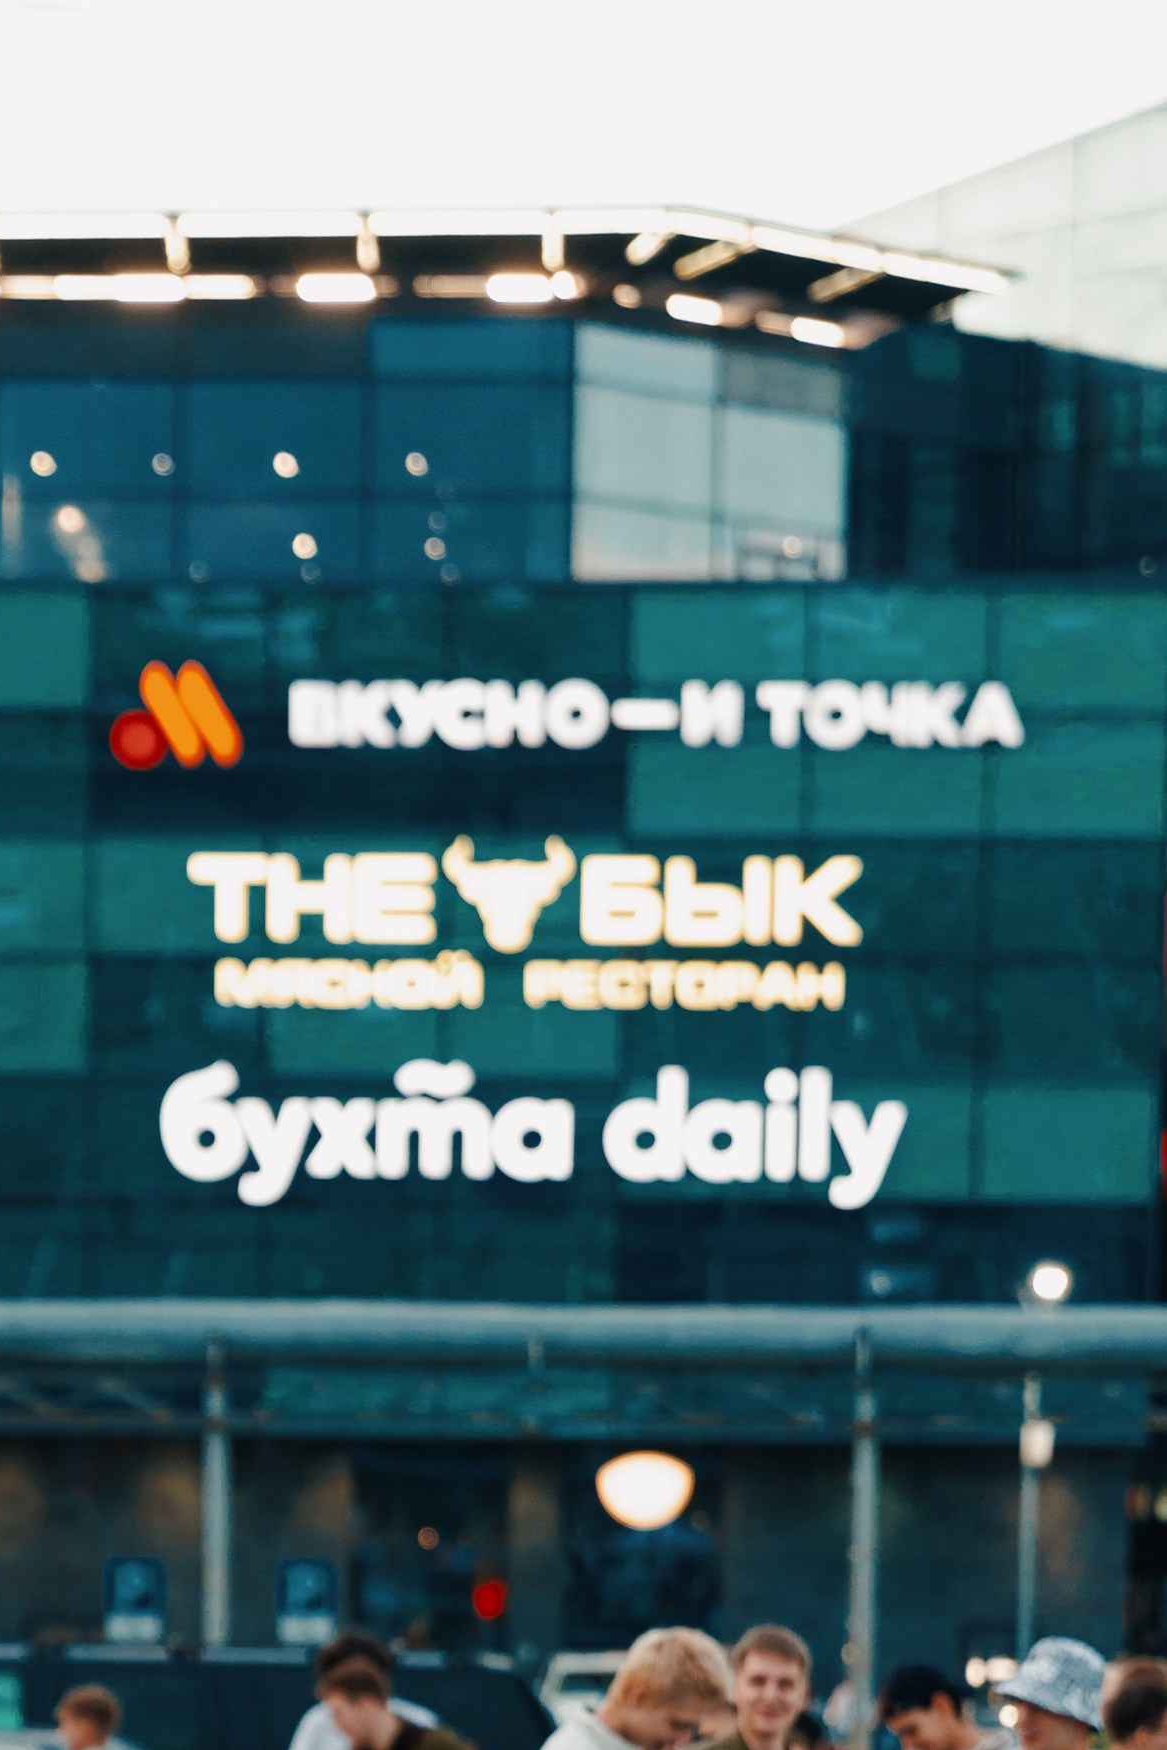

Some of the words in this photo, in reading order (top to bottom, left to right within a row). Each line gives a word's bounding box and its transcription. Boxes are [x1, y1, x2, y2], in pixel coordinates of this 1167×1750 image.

[755, 679, 1025, 749] ТОЧКА
[186, 851, 438, 945] THE
[579, 853, 863, 947] БЫК
[522, 958, 847, 1012] РЕСТОРАН
[602, 1064, 908, 1210] daily
